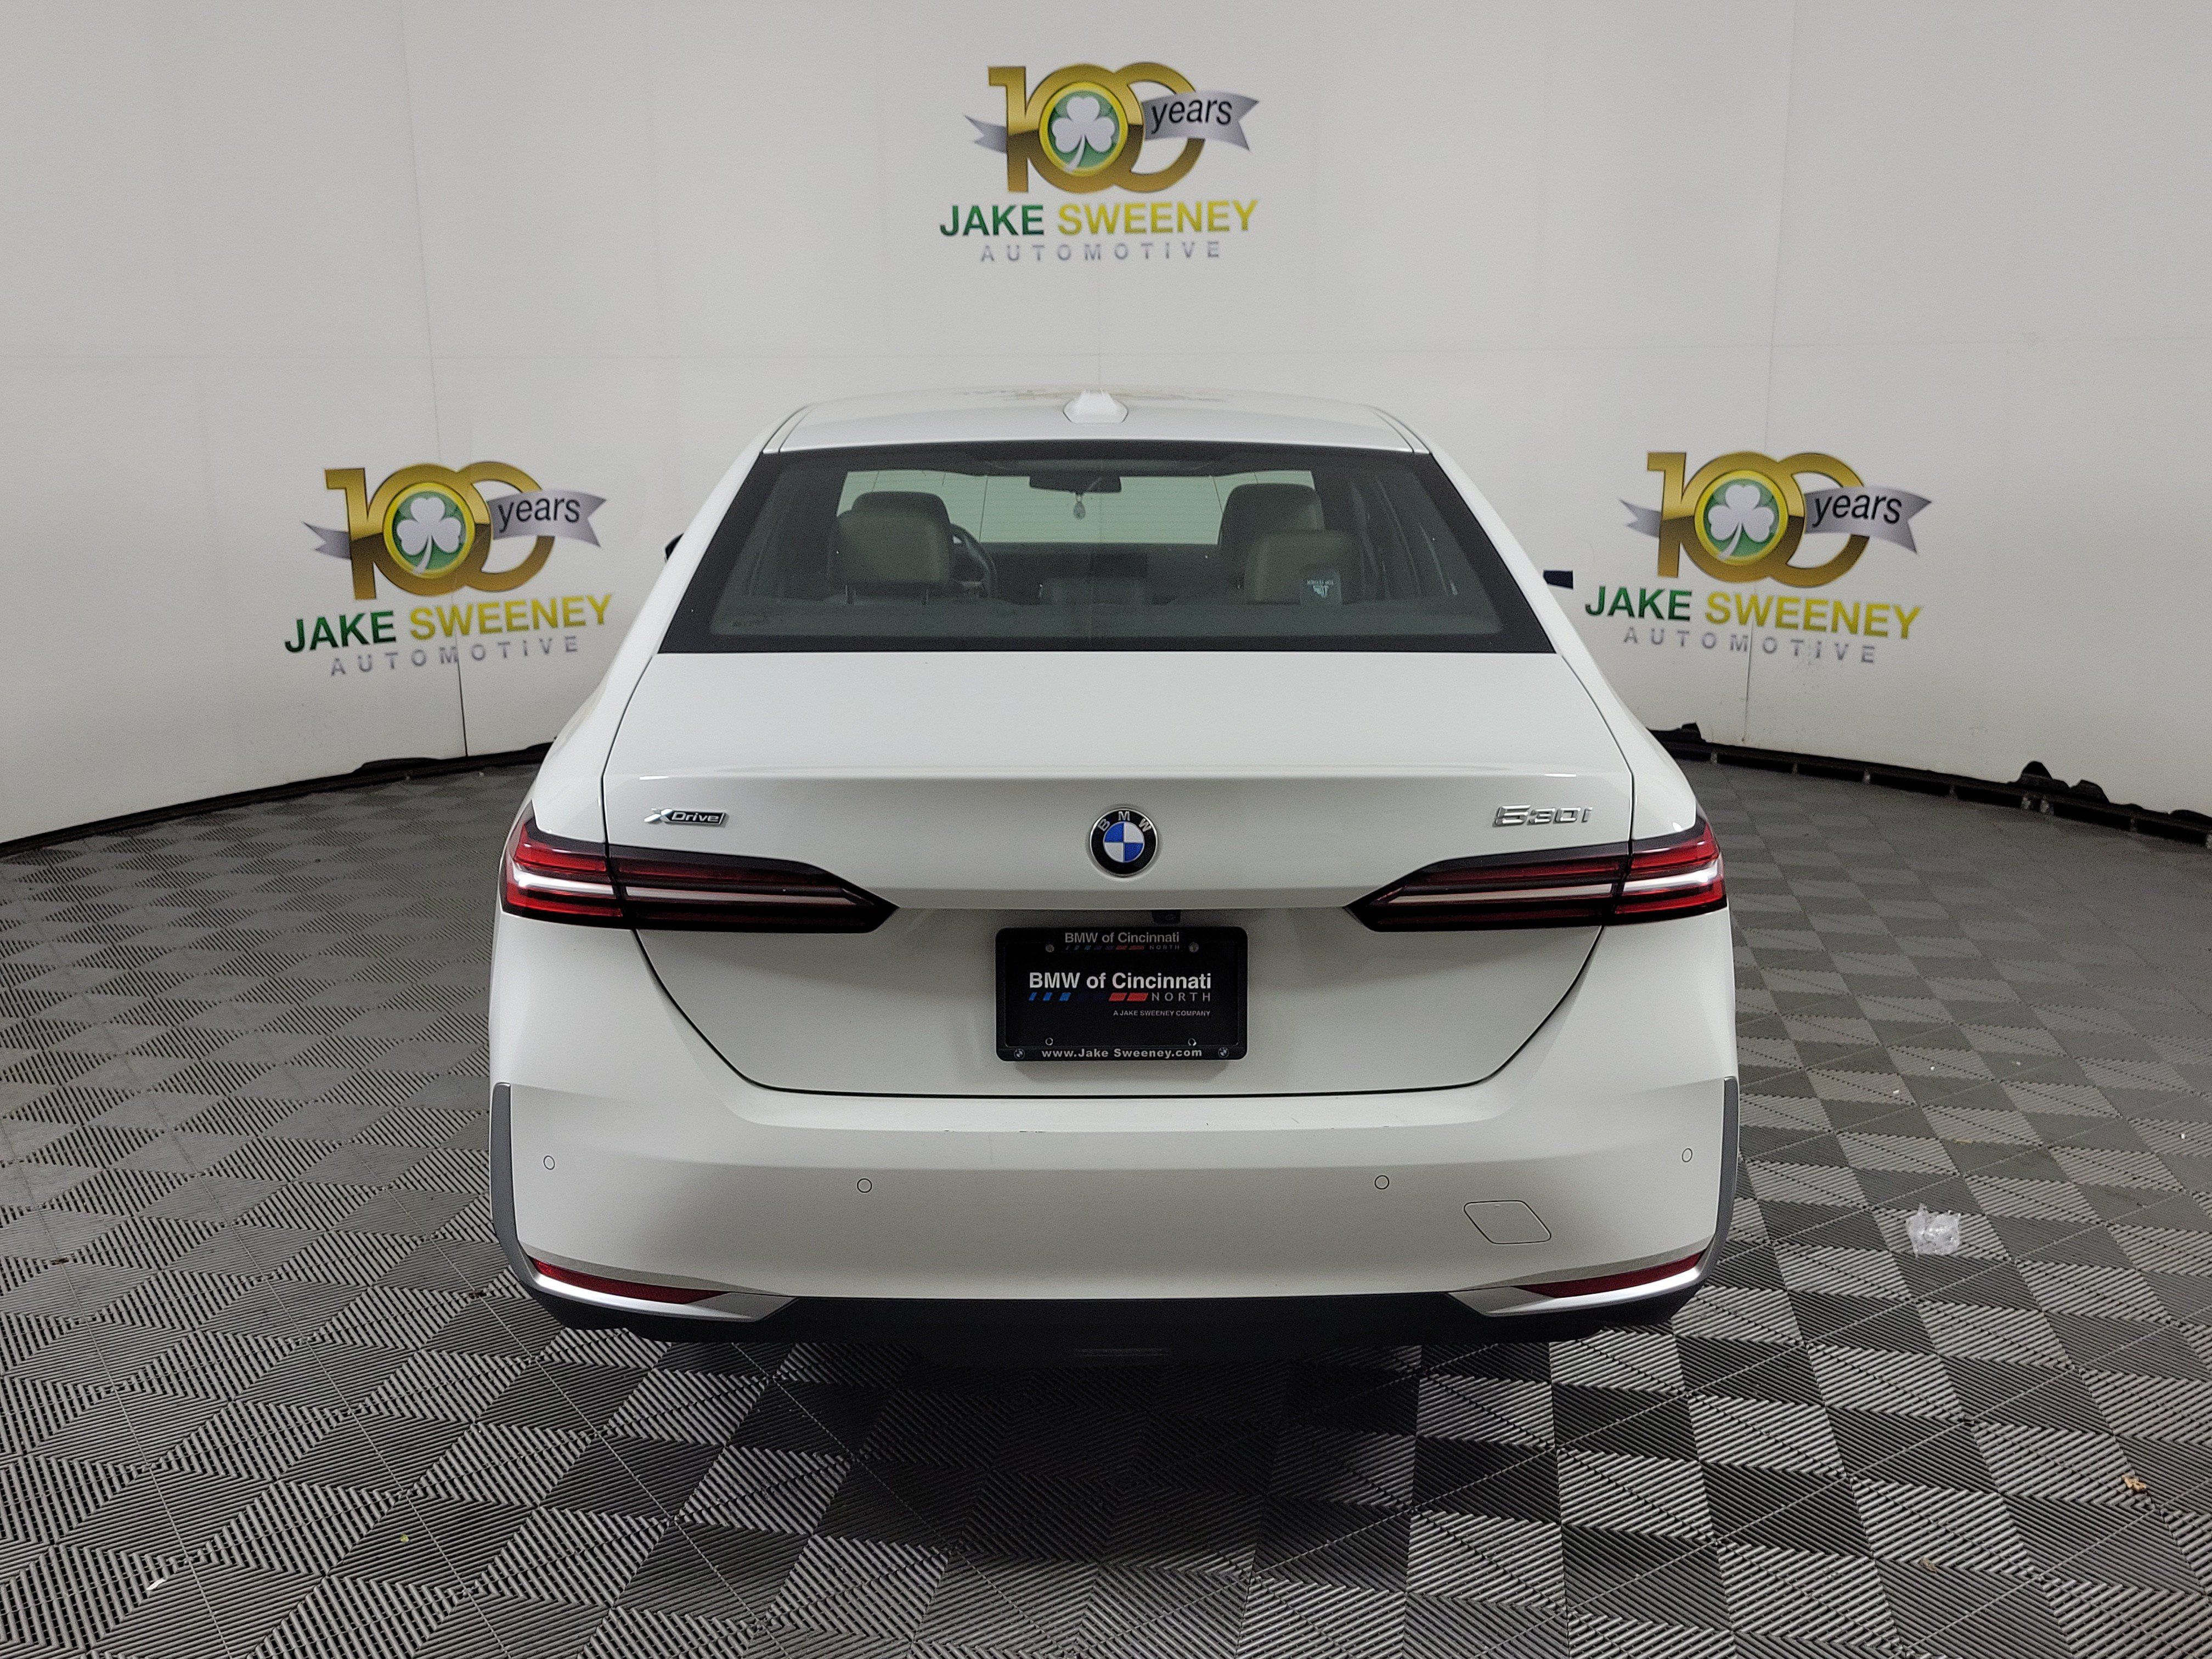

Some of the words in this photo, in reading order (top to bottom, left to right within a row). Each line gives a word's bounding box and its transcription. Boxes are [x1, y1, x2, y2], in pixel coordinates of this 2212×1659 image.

[1151, 98, 1232, 134] years
[939, 204, 1044, 236] JAKE
[1058, 199, 1258, 236] SWEENEY
[980, 241, 1220, 262] AUTOMOTIVE
[498, 495, 580, 533] years
[1812, 493, 1903, 527] years
[284, 610, 396, 653] JAKE
[410, 594, 613, 641] SWEENEY
[1585, 586, 1692, 622] JAKE
[1705, 591, 1922, 639] SWEENEY
[330, 635, 579, 676] AUTOMOTIVE
[1623, 627, 1877, 663] AUTOMOTIVE
[1097, 810, 1152, 832] BMW
[1493, 804, 1593, 826] 530i
[1065, 932, 1098, 943] BMW
[1102, 932, 1114, 943] of
[1118, 932, 1180, 943] Cincinnati
[1029, 972, 1081, 988] BMW
[1086, 972, 1106, 988] of
[1112, 972, 1211, 989] Cincinnati
[1152, 992, 1211, 1002] NORTH
[1042, 1048, 1109, 1058] www.Jake
[1114, 1048, 1203, 1059] Sweeney.com
